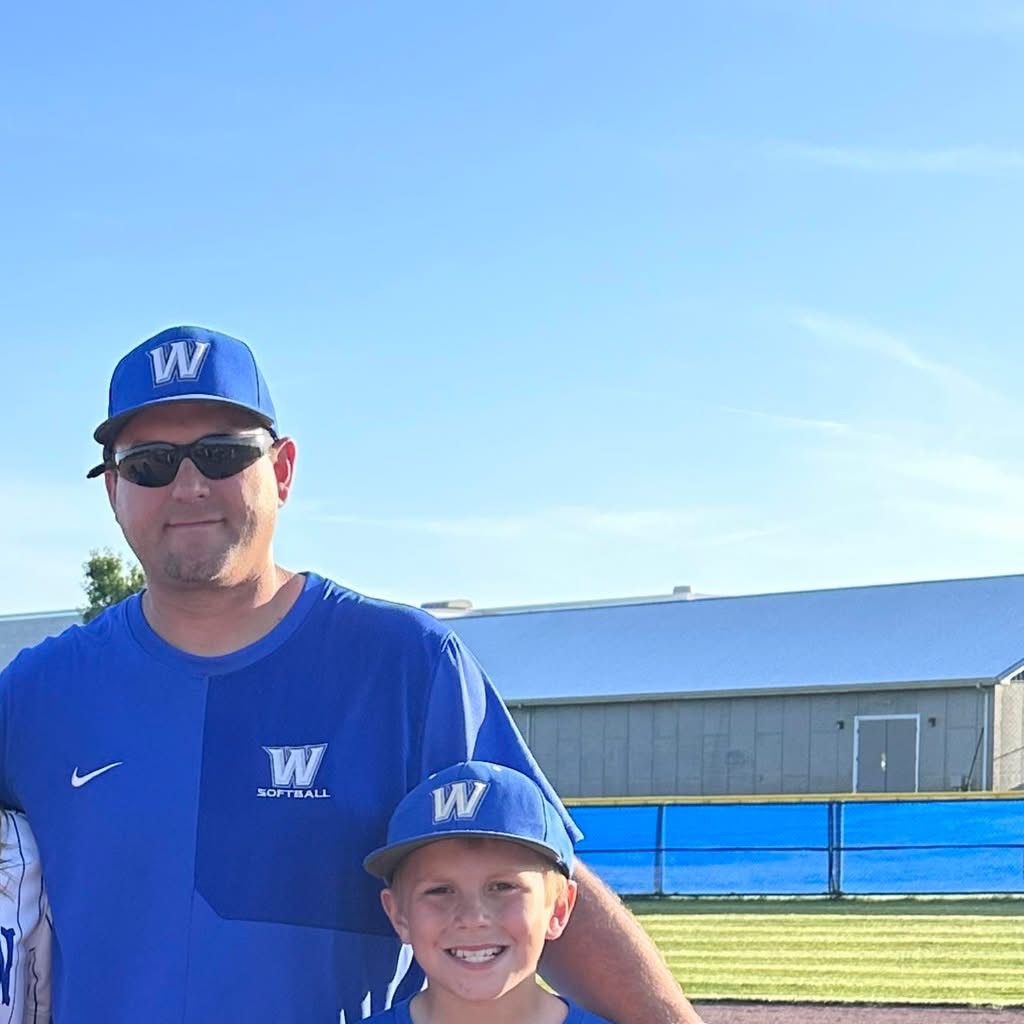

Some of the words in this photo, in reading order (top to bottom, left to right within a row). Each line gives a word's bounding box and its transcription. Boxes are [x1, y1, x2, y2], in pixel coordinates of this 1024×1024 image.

[148, 339, 211, 388] W
[262, 743, 328, 788] W
[257, 788, 331, 798] SOFTBALL
[430, 780, 491, 825] W
